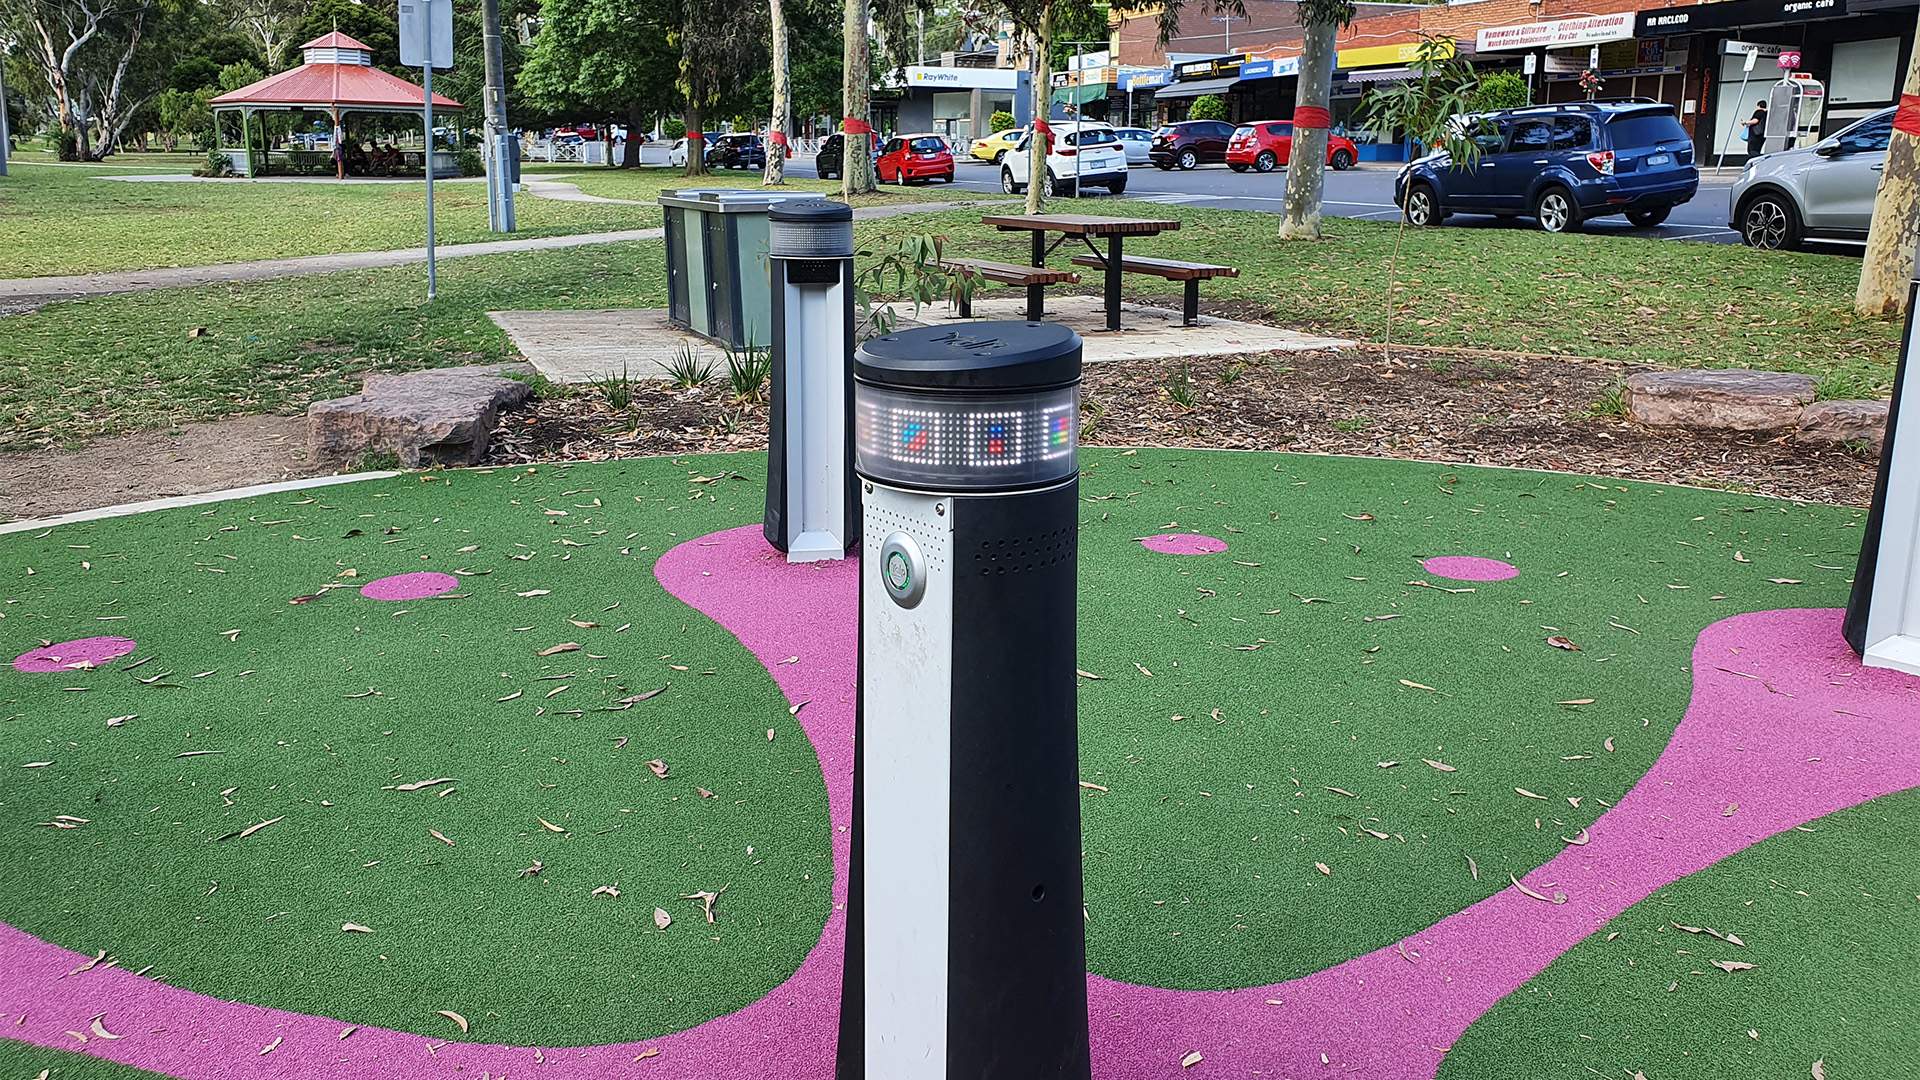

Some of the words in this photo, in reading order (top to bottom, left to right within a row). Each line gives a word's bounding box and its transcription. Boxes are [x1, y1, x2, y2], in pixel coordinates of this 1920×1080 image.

[1784, 2, 1813, 13] organic
[1558, 21, 1587, 31] Clothing
[1587, 16, 1624, 29] Alteration
[1658, 14, 1689, 25] MACLEOD
[1485, 29, 1515, 39] Homeware
[1520, 35, 1552, 44] Replacement
[1644, 54, 1662, 62] HERE
[1132, 73, 1164, 86] Bottlemart
